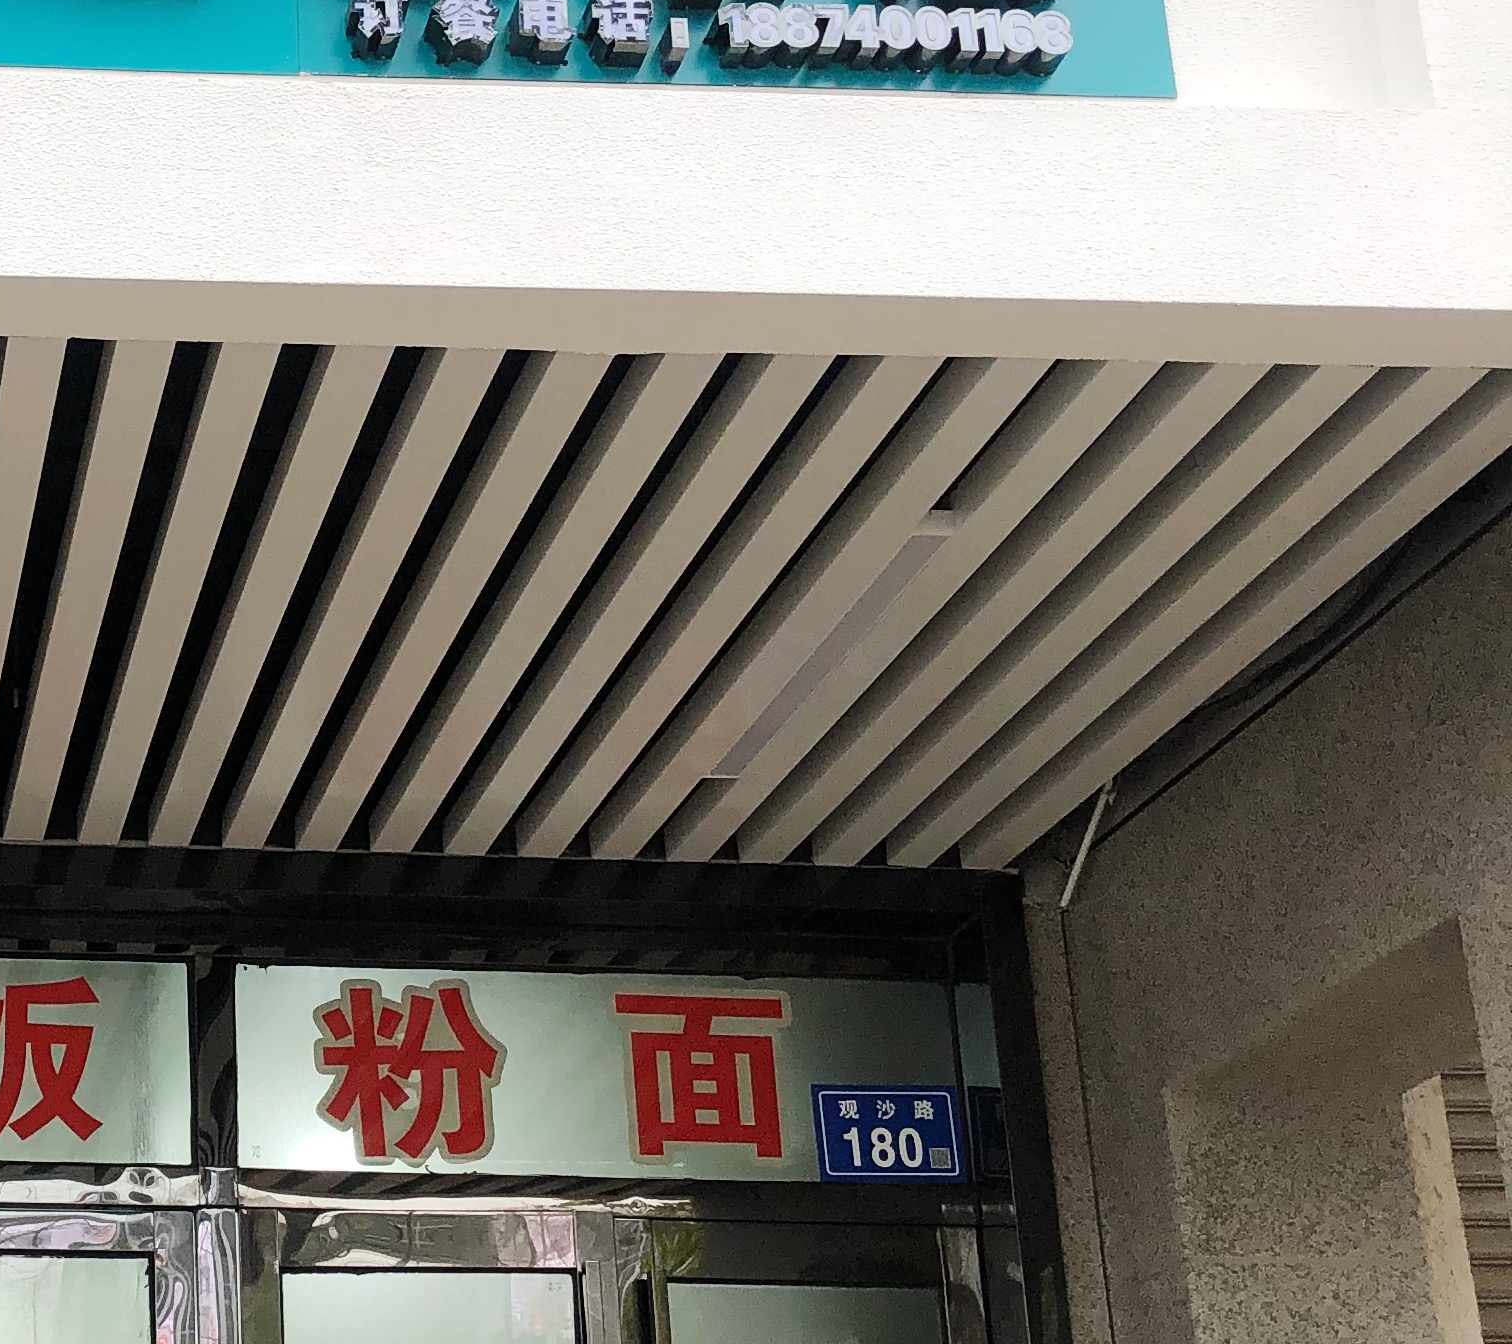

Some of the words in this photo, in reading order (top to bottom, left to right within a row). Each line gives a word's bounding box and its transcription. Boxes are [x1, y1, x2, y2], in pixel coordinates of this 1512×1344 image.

[718, 2, 1073, 54] 18874001168
[316, 981, 788, 1163] 粉面
[838, 1099, 935, 1120] 观沙路
[843, 1126, 924, 1168] 180
